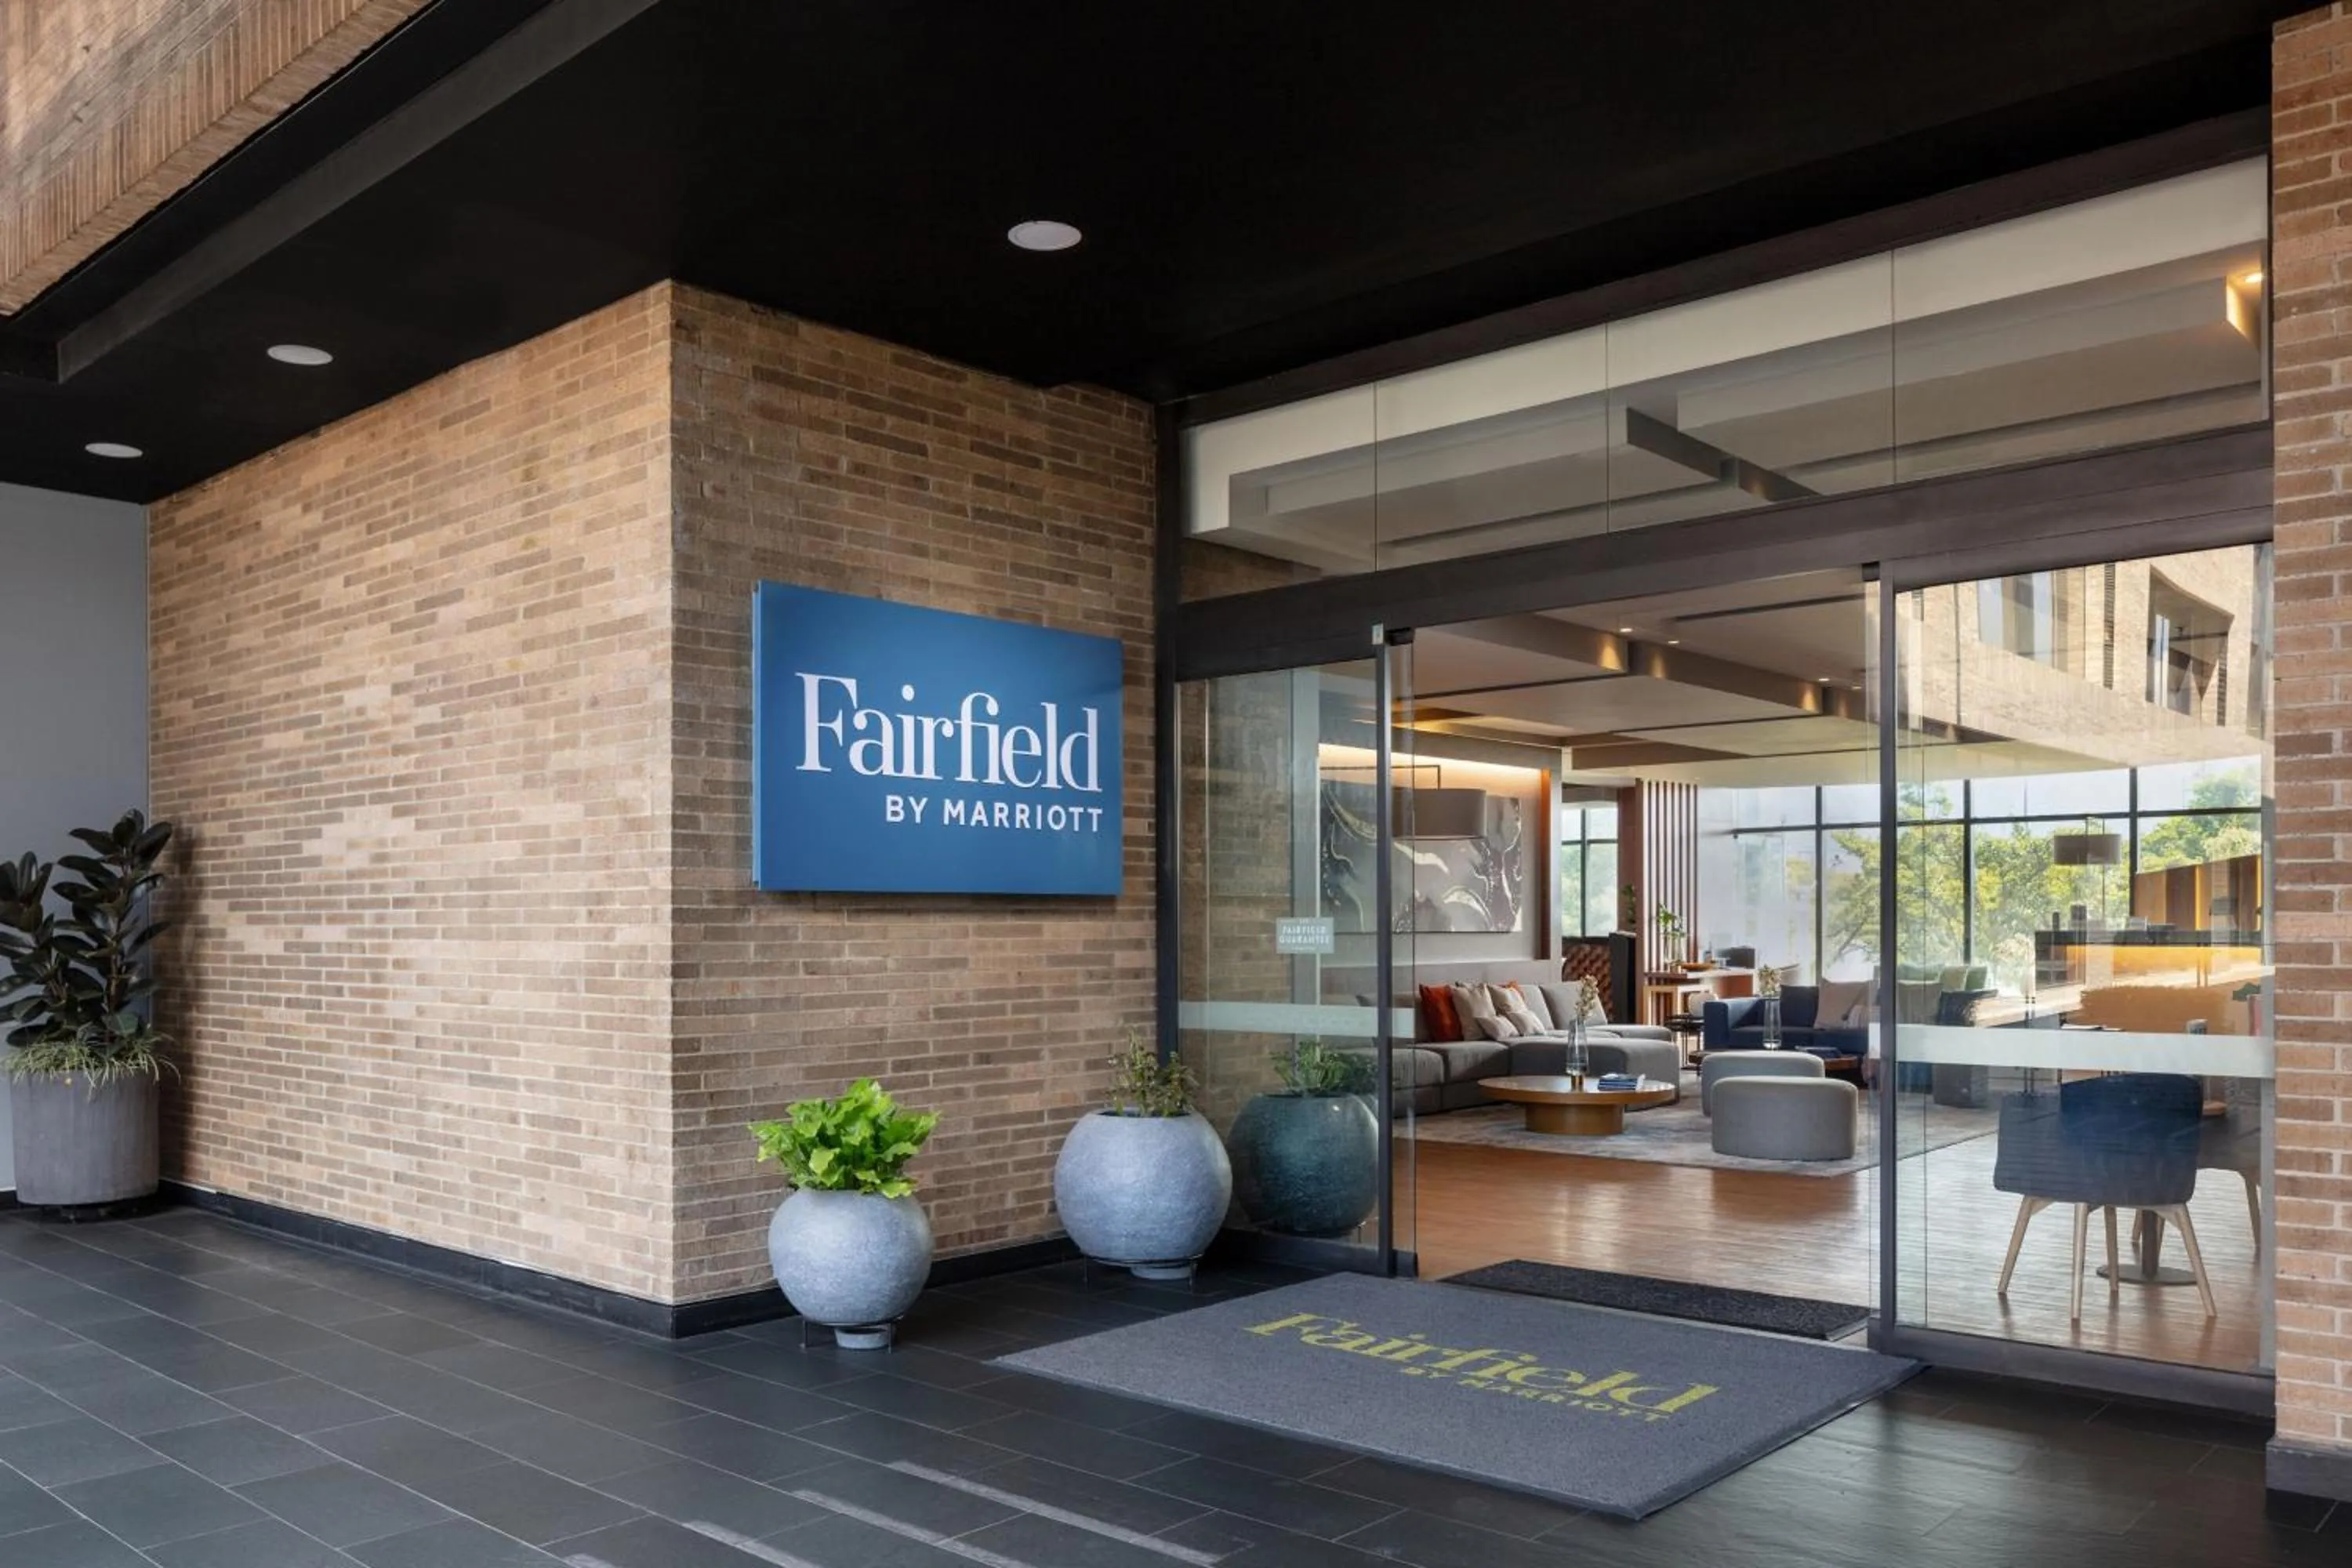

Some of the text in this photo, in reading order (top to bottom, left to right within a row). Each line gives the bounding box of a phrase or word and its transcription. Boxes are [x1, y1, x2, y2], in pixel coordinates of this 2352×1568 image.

[794, 672, 1102, 793] Fairfield
[886, 795, 1103, 832] BY MARRIOTT
[1242, 1312, 1720, 1414] Fairfield
[1399, 1367, 1671, 1421] BY MARRIOTT
